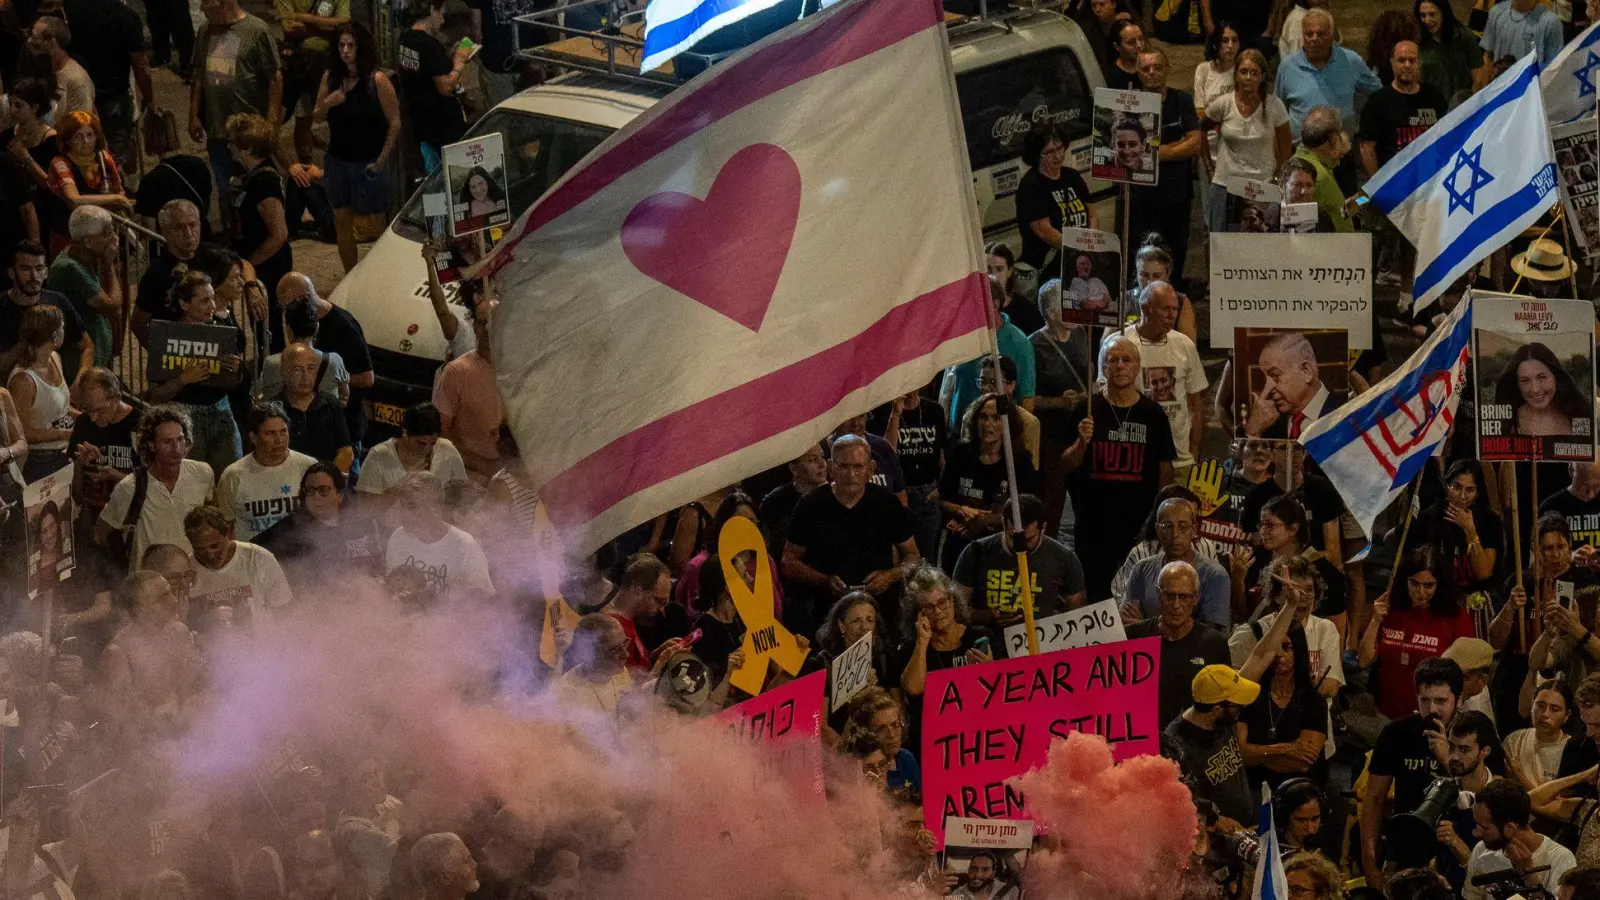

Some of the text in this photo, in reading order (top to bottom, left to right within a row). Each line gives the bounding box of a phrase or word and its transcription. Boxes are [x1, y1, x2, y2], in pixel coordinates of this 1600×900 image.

[472, 154, 483, 165] 20
[1282, 269, 1302, 280] את
[1228, 299, 1288, 311] החטופים
[1292, 300, 1312, 311] את
[1317, 297, 1367, 314] להפקיר
[1514, 312, 1553, 322] NAAMA LEVY
[1543, 321, 1558, 331] 20
[166, 339, 219, 357] עסקה
[1481, 404, 1513, 420] BRING
[1481, 420, 1502, 436] HER
[1481, 436, 1511, 454] HOME
[751, 625, 780, 654] NOW.
[938, 651, 1155, 715] A YEAR AND
[933, 723, 1026, 770] THEY
[963, 823, 1017, 837] מתן עדיין חי
